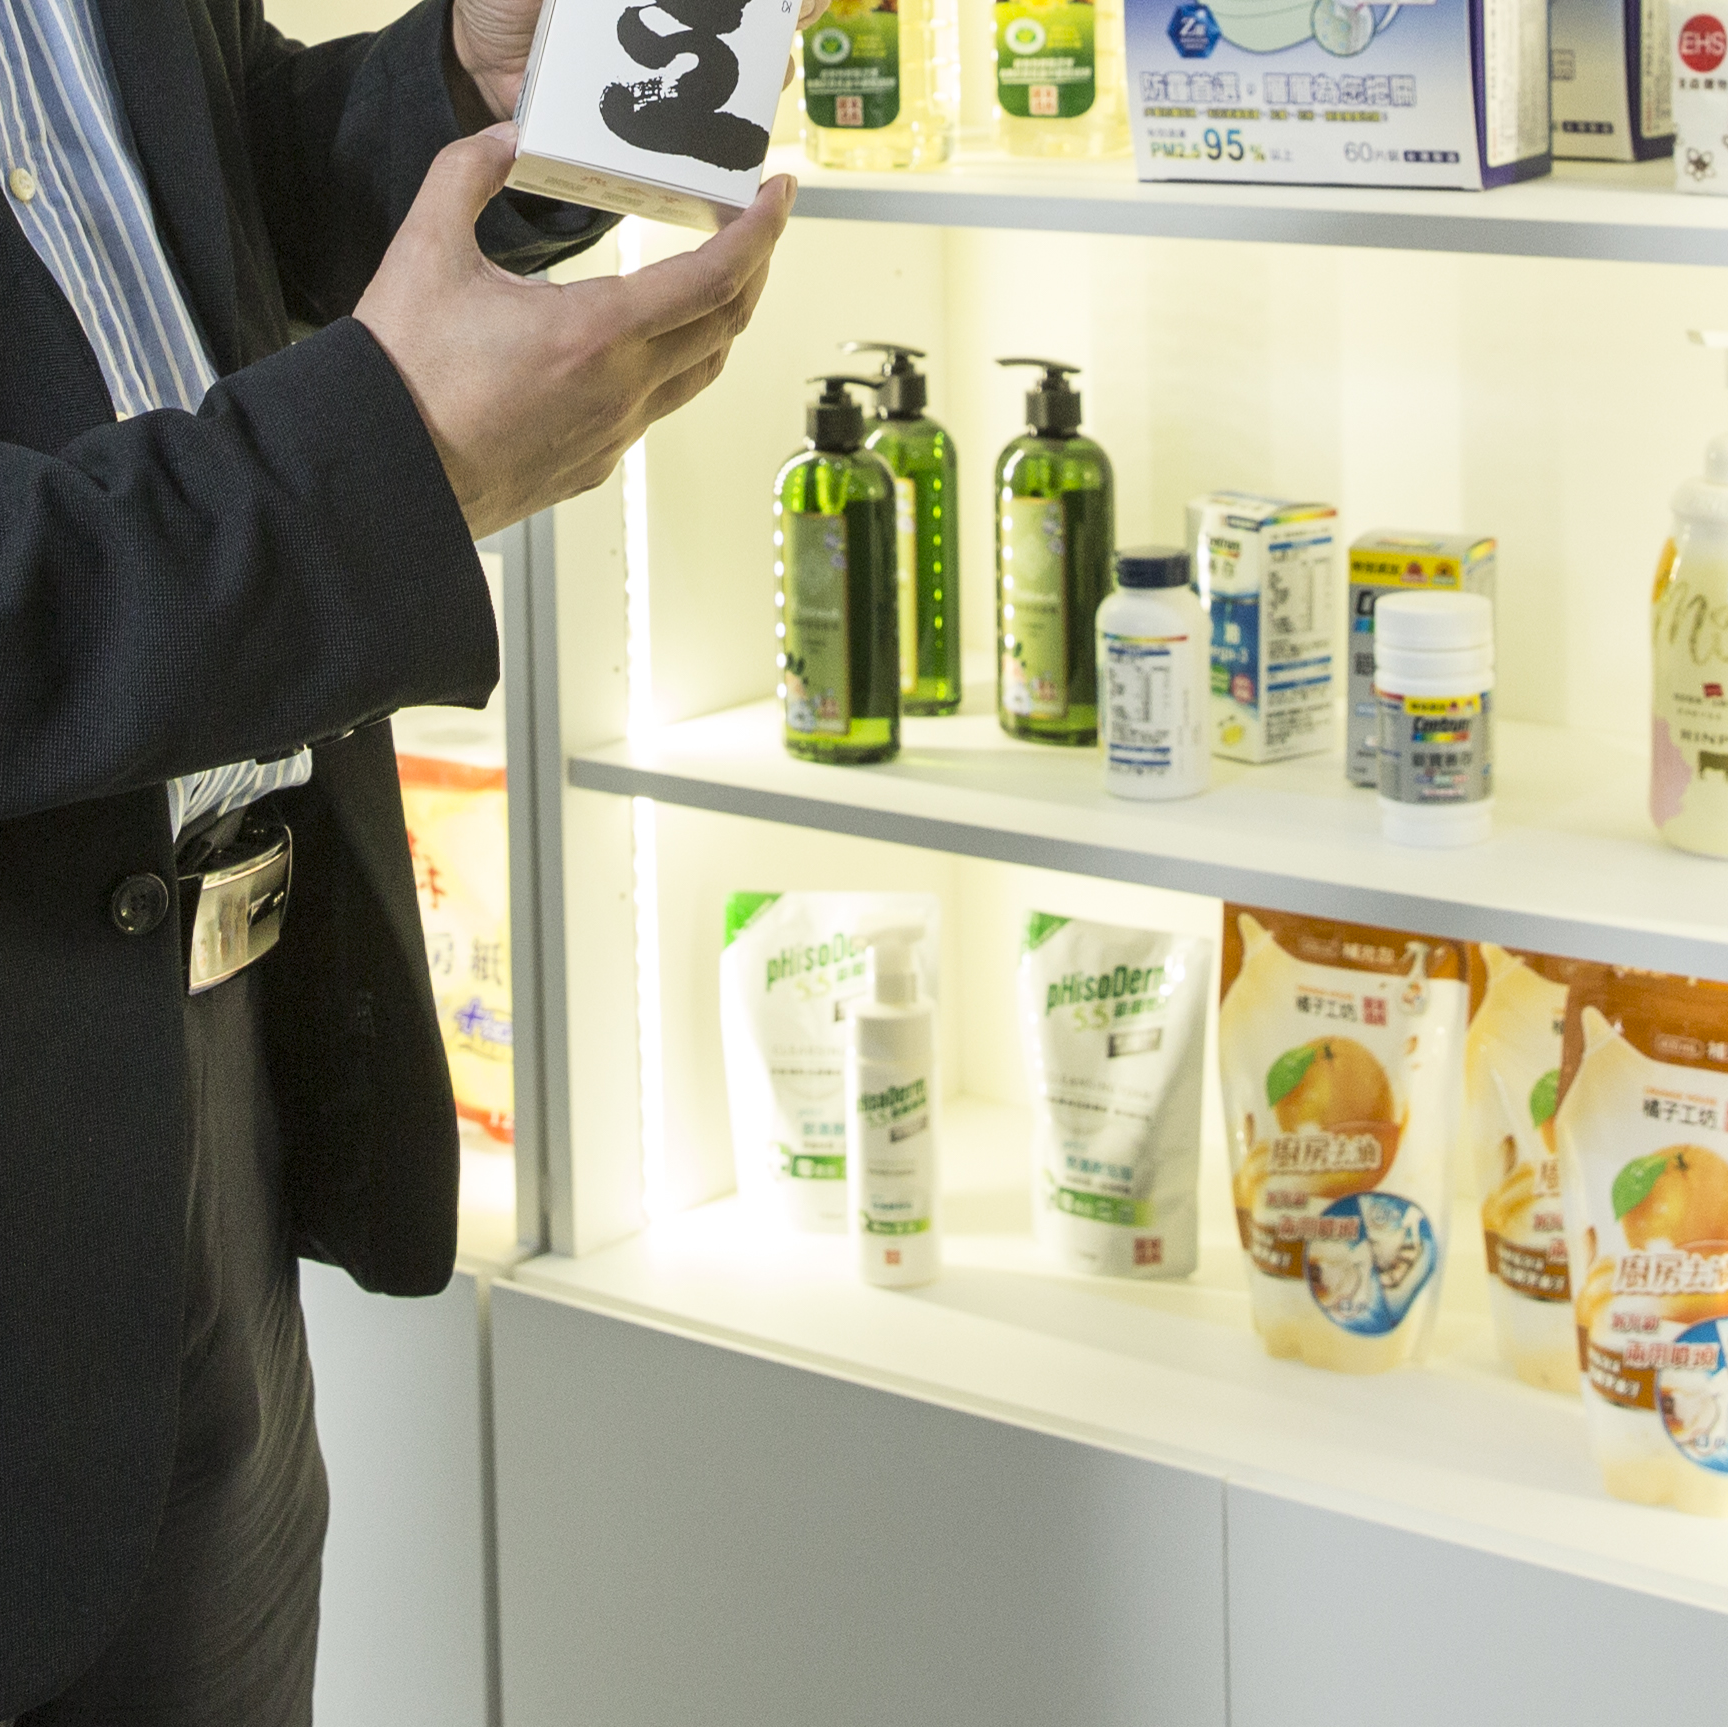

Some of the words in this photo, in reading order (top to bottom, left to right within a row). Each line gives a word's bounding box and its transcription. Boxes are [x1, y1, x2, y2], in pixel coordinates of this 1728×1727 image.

[1681, 30, 1724, 56] EHS
[1294, 995, 1357, 1022] 橘子工坊
[1641, 1098, 1719, 1130] 橘子工坊
[1273, 1135, 1381, 1170] 廚房去油
